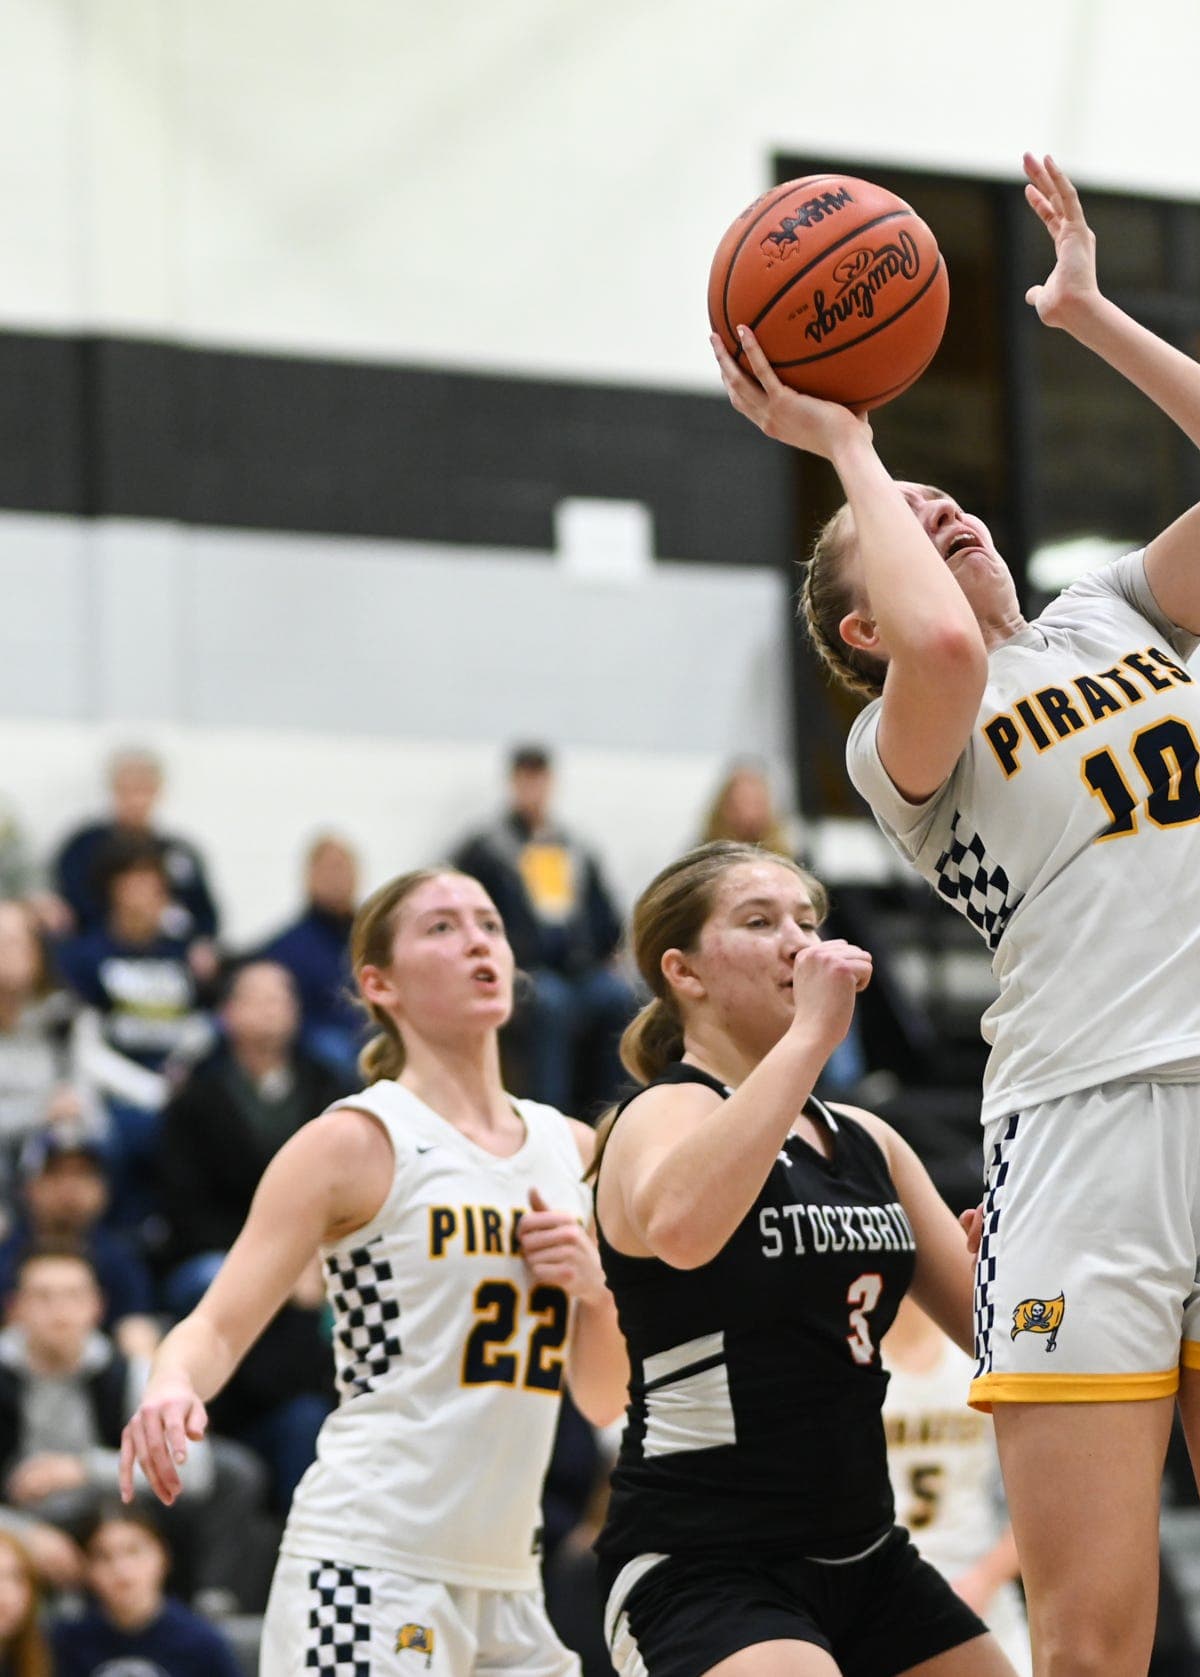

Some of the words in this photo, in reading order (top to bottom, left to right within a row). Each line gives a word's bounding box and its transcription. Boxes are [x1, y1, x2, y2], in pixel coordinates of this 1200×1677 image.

[805, 230, 920, 343] Rawlings
[981, 646, 1196, 781] PIRATES
[459, 1277, 570, 1396] 22
[846, 1272, 884, 1369] 3
[907, 1462, 944, 1530] 5
